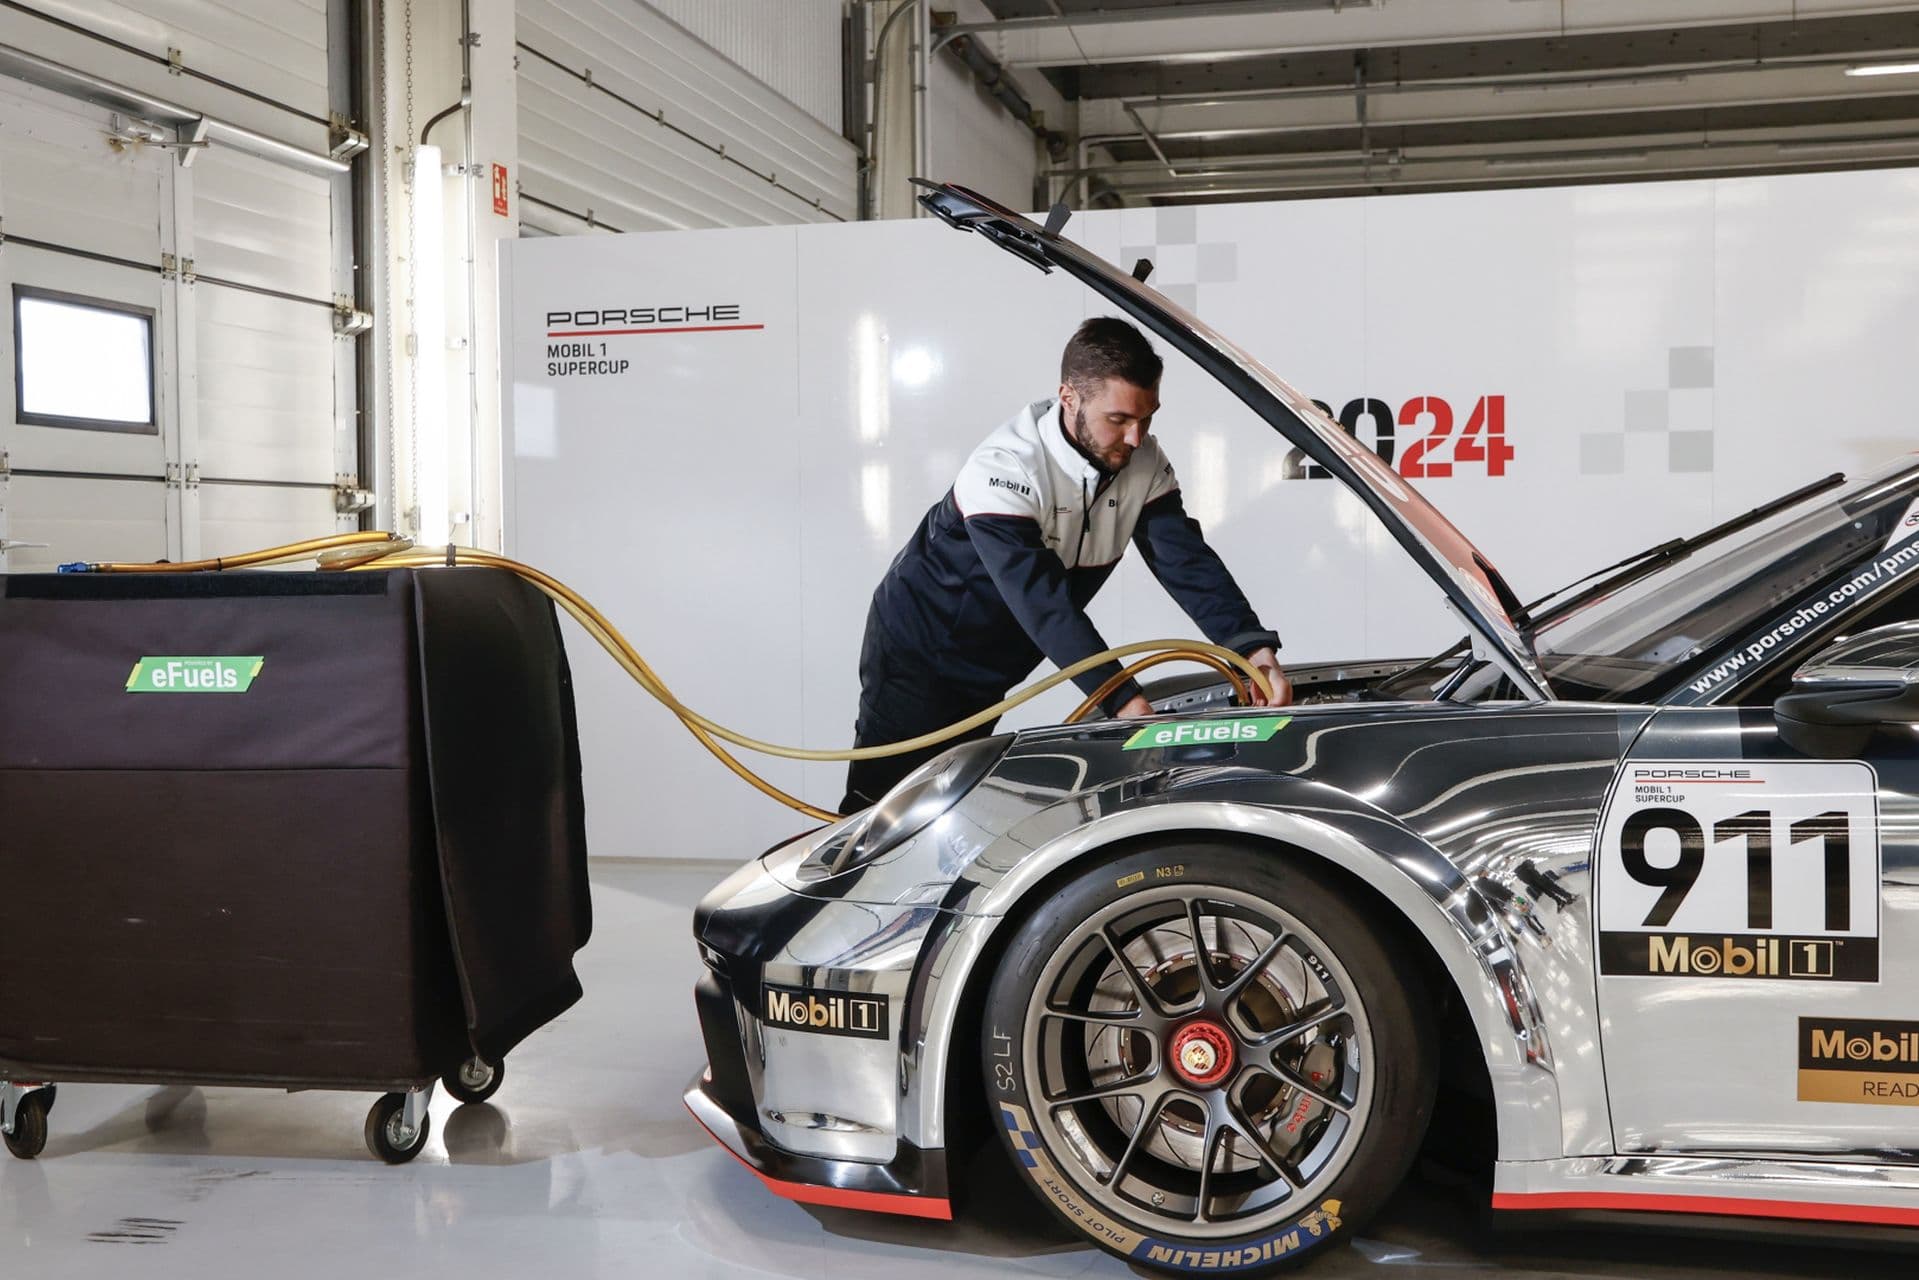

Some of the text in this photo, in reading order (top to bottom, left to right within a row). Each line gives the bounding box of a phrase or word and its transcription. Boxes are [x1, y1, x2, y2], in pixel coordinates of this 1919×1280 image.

[547, 304, 740, 328] PORSCHE
[547, 342, 607, 359] MOBIL 1
[547, 360, 630, 376] SUPERCUP
[988, 477, 1020, 492] Mobil
[151, 661, 238, 688] eFuels
[1155, 721, 1258, 744] eFuels
[1634, 769, 1751, 779] PORSCHE
[1635, 786, 1672, 794] MOBIL 1
[1635, 795, 1685, 803] SUPERCUP
[1620, 807, 1851, 932] 911
[1308, 955, 1329, 979] 911
[1649, 936, 1779, 976] Mobil
[767, 990, 845, 1029] Mobil
[1811, 1029, 1919, 1062] Mobil
[1043, 1179, 1126, 1244] PILOT SPORT
[1147, 1230, 1301, 1268] MICHELIN
